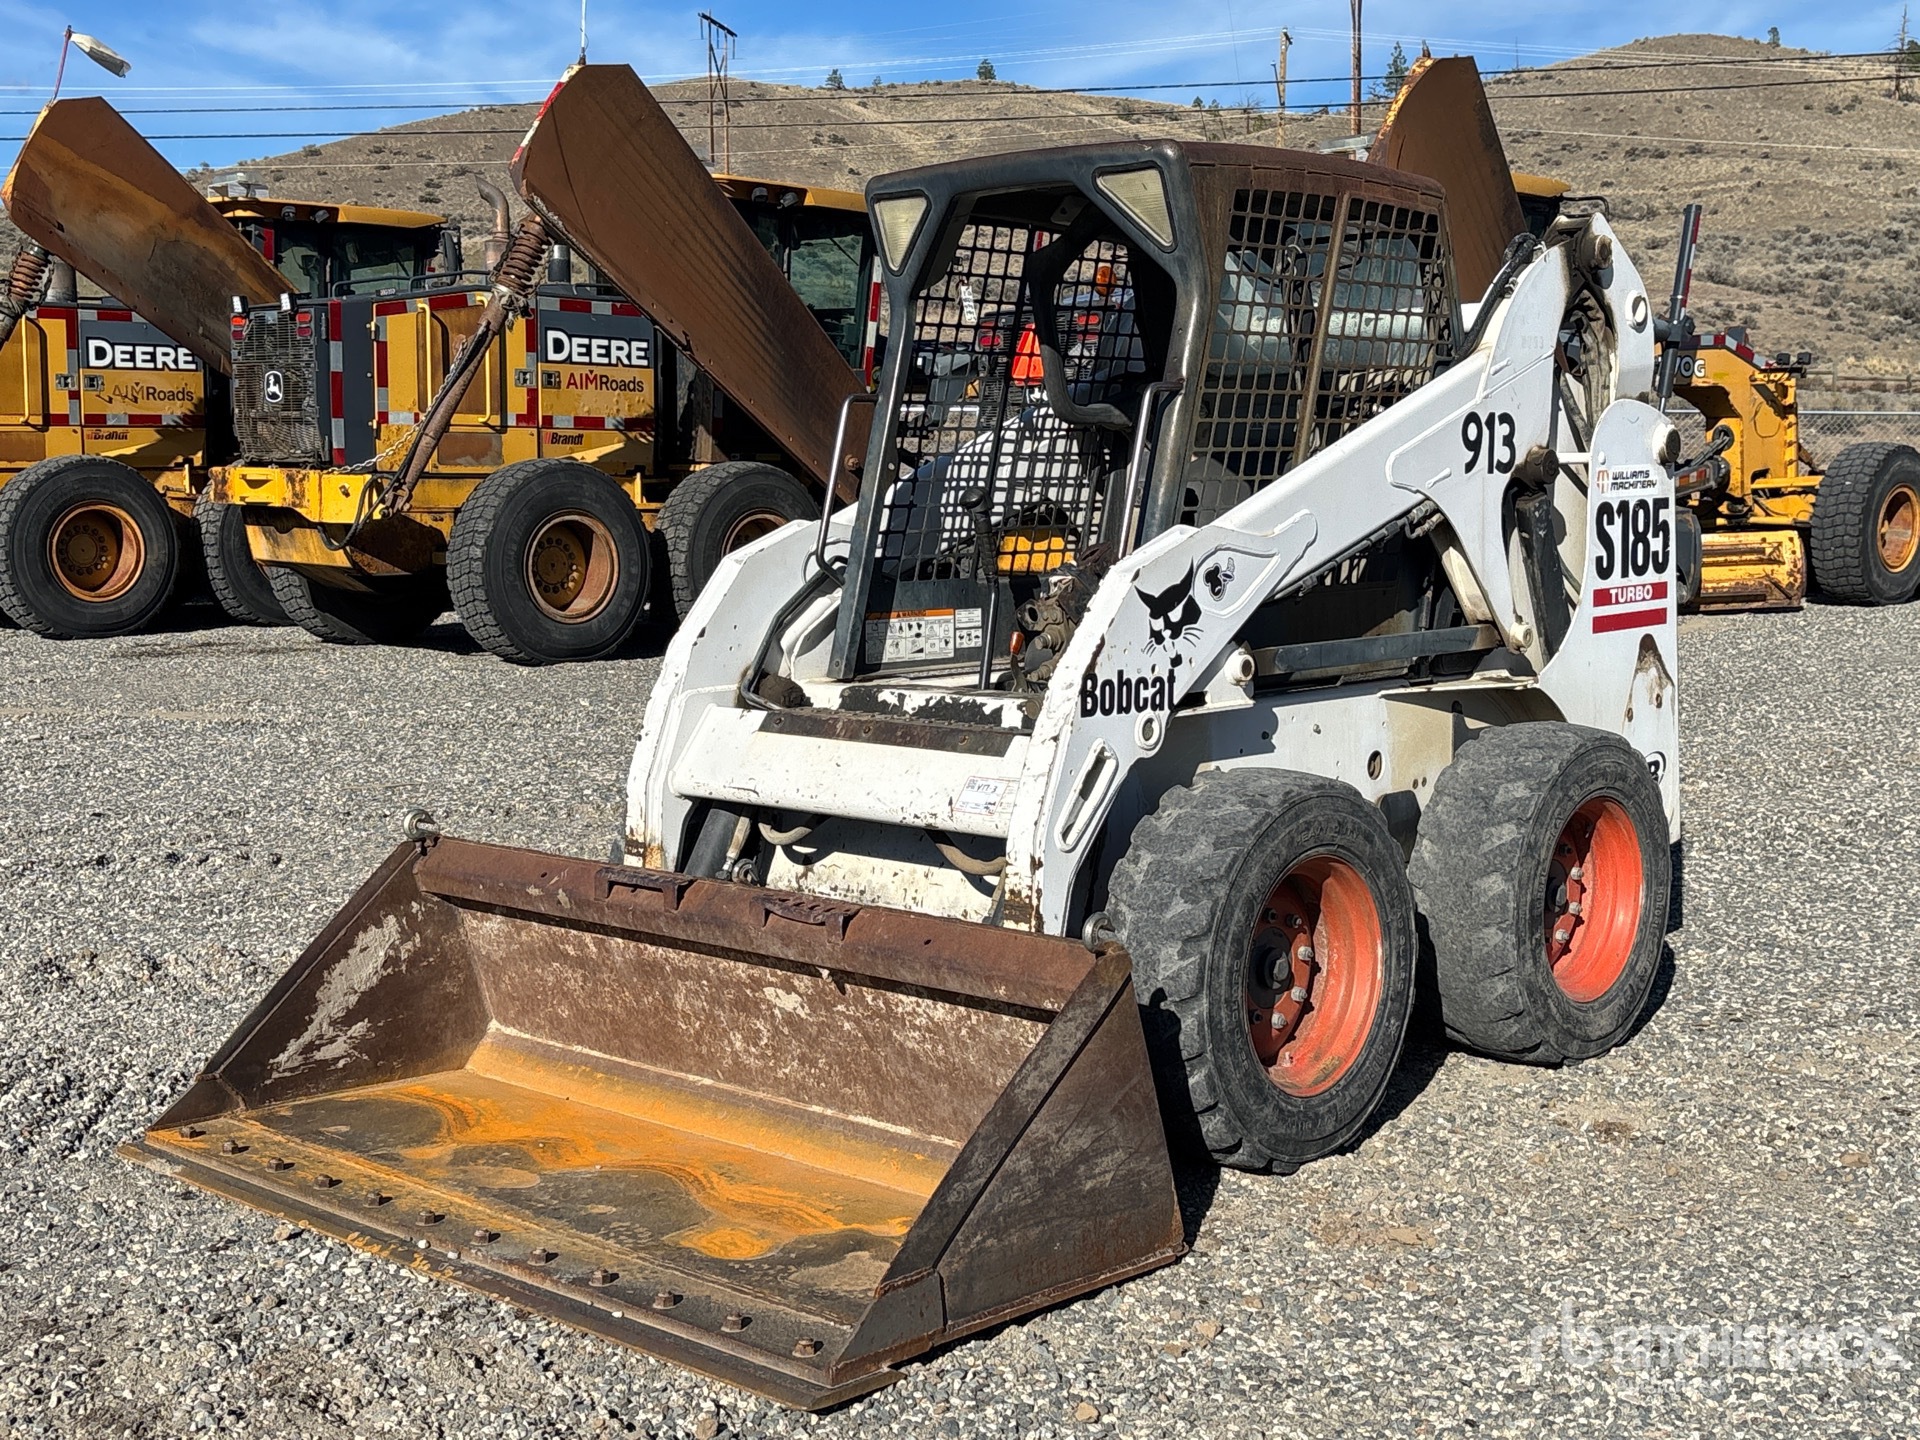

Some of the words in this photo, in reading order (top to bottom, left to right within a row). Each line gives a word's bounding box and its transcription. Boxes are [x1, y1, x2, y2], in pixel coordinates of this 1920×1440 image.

[87, 338, 197, 370] DEERE
[546, 329, 649, 366] DEERE
[566, 370, 645, 393] AIMRoads
[550, 431, 584, 446] Brandt
[1461, 411, 1516, 475] 913
[1610, 479, 1658, 491] MACHINERY
[1612, 469, 1651, 482] WILLIAMS
[1595, 496, 1670, 581] S185
[1609, 584, 1653, 604] TURBO
[1080, 668, 1177, 719] Bobcat
